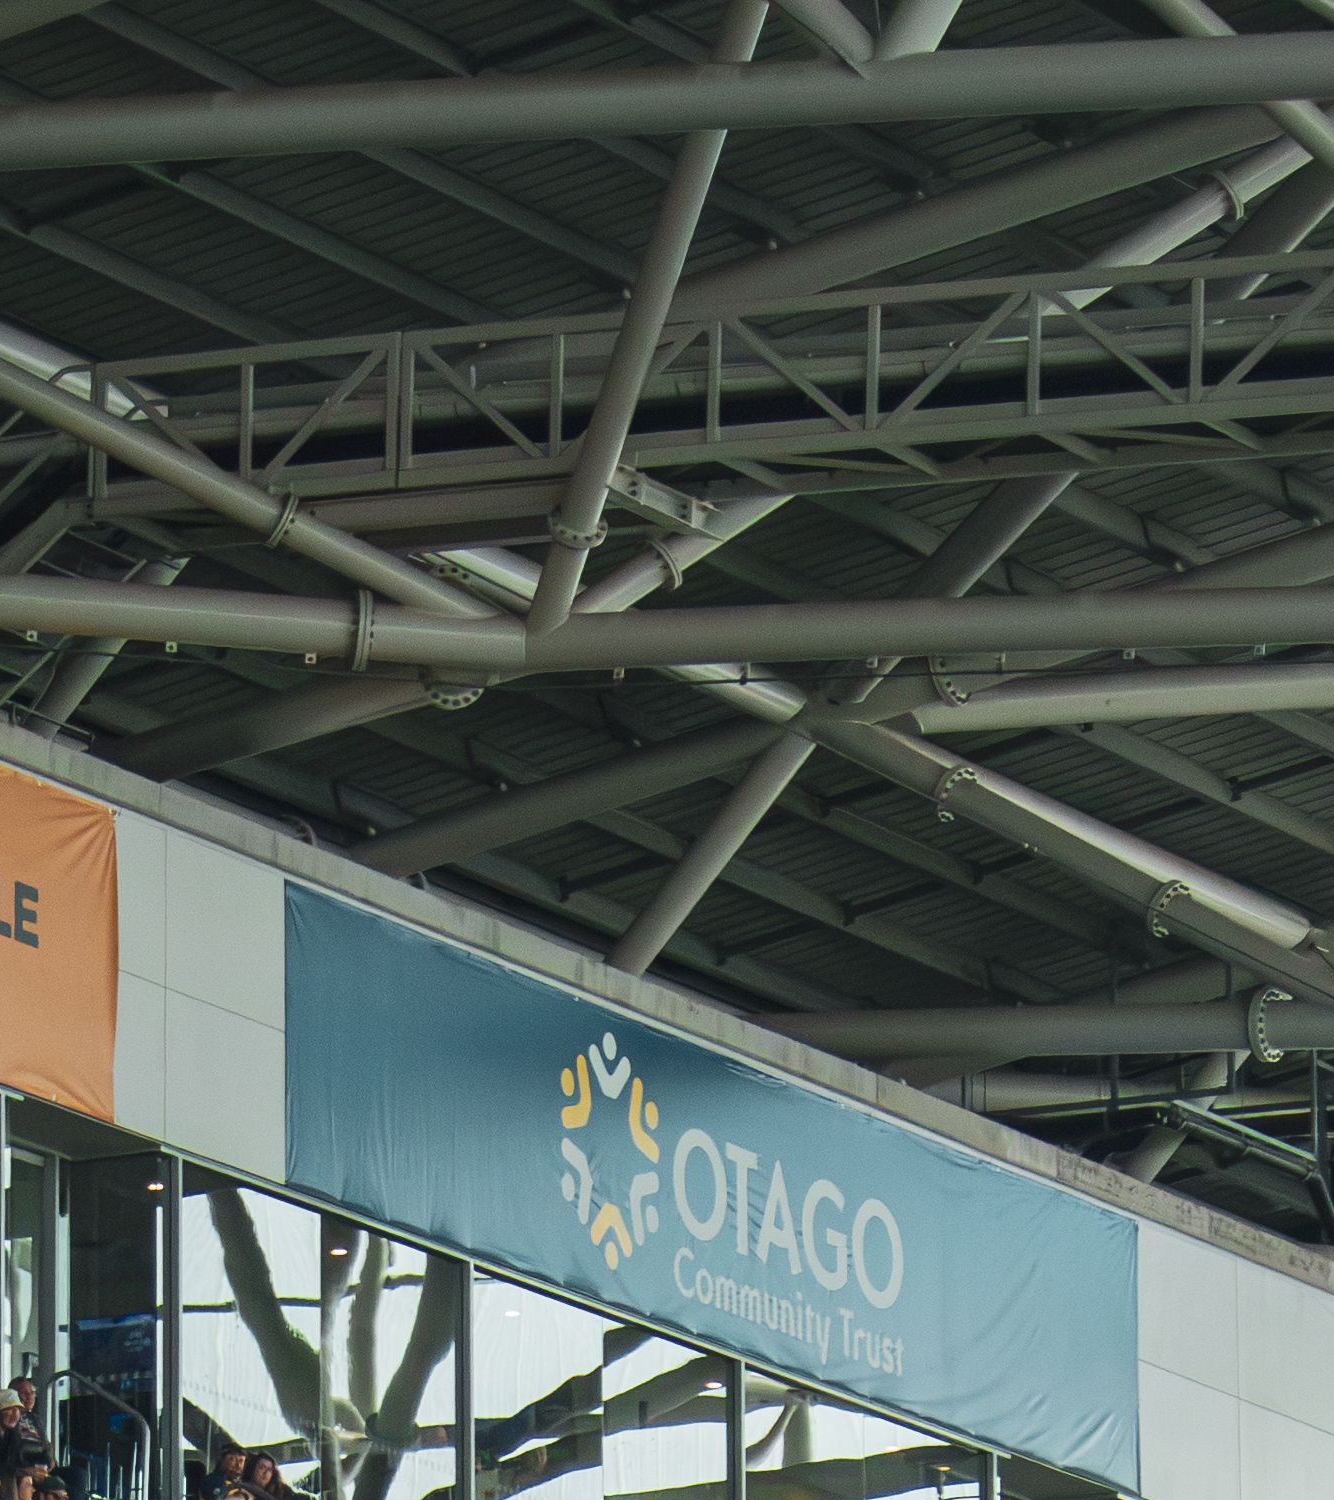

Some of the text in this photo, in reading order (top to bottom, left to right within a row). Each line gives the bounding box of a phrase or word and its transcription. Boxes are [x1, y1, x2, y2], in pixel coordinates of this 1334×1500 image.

[672, 1128, 904, 1309] OTAGO
[673, 1247, 905, 1376] Community Trust
